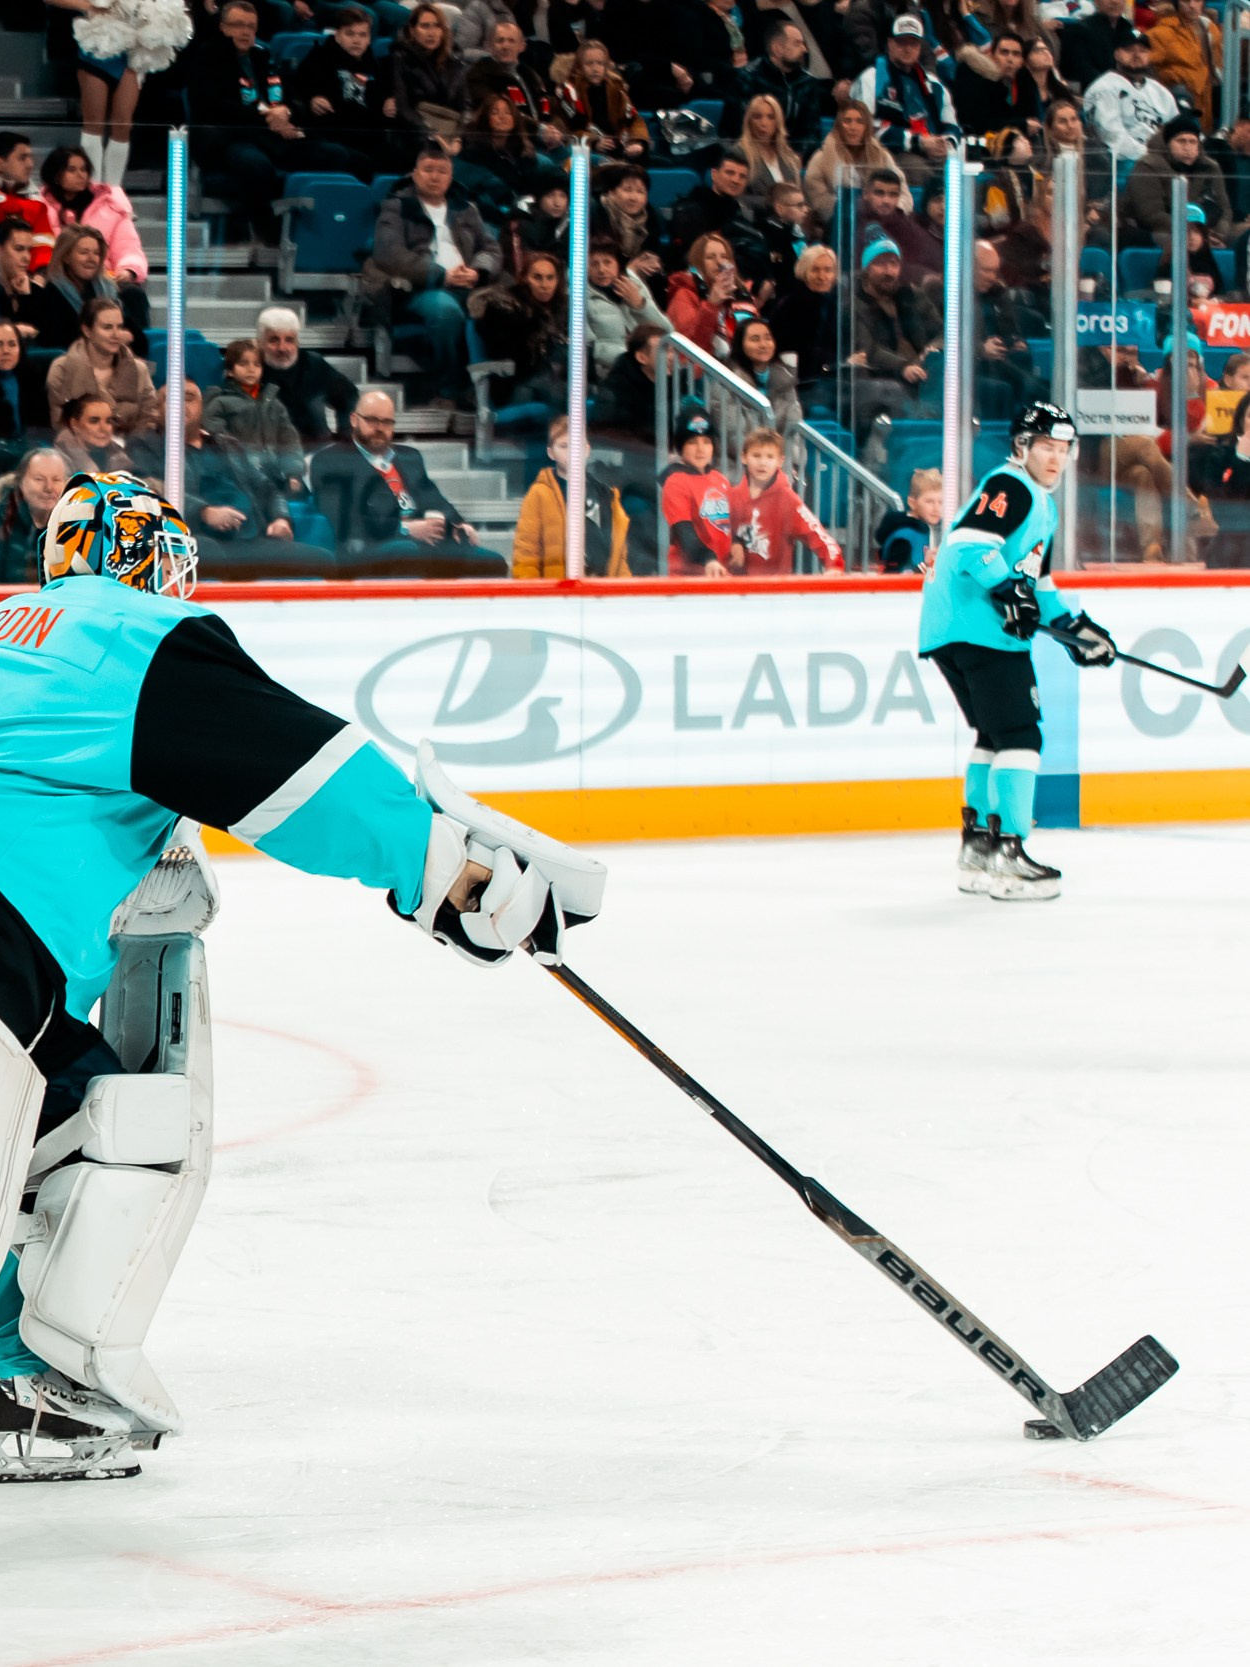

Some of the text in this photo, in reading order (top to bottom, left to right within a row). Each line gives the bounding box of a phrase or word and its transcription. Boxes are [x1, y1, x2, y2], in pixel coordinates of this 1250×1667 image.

[1208, 312, 1250, 337] FON
[975, 491, 1008, 518] 14
[674, 651, 936, 730] LADA
